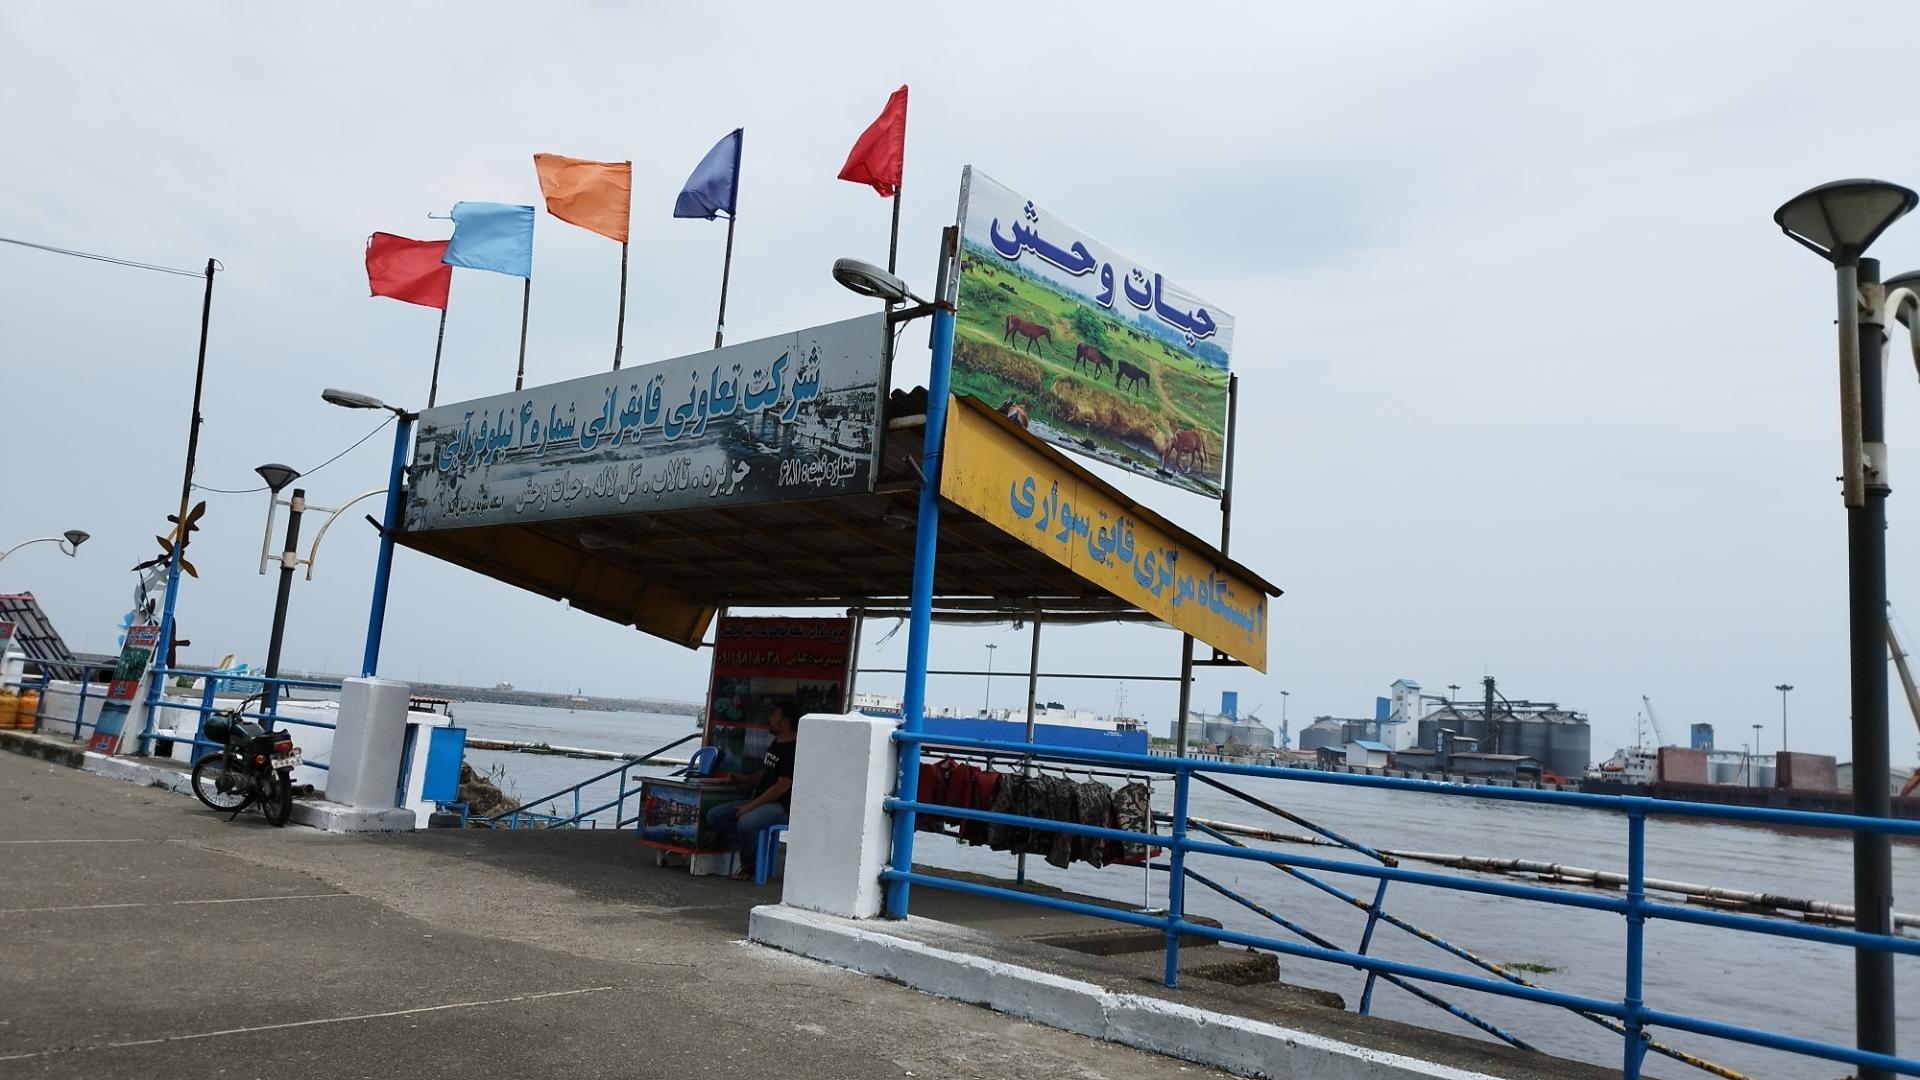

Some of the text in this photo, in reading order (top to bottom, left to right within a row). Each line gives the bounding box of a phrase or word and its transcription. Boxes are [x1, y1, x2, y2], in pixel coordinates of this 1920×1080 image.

[989, 199, 1218, 347] حیات وحش
[438, 346, 821, 472] شرکت تعاونی قایقرانی شماره ۴ نیلوفر آبی
[826, 455, 856, 486] شماره
[515, 457, 751, 512] جزیره تالاب گل لاله حیات وحش
[1010, 476, 1263, 643] ایستگاه مرکزی قایق سواری
